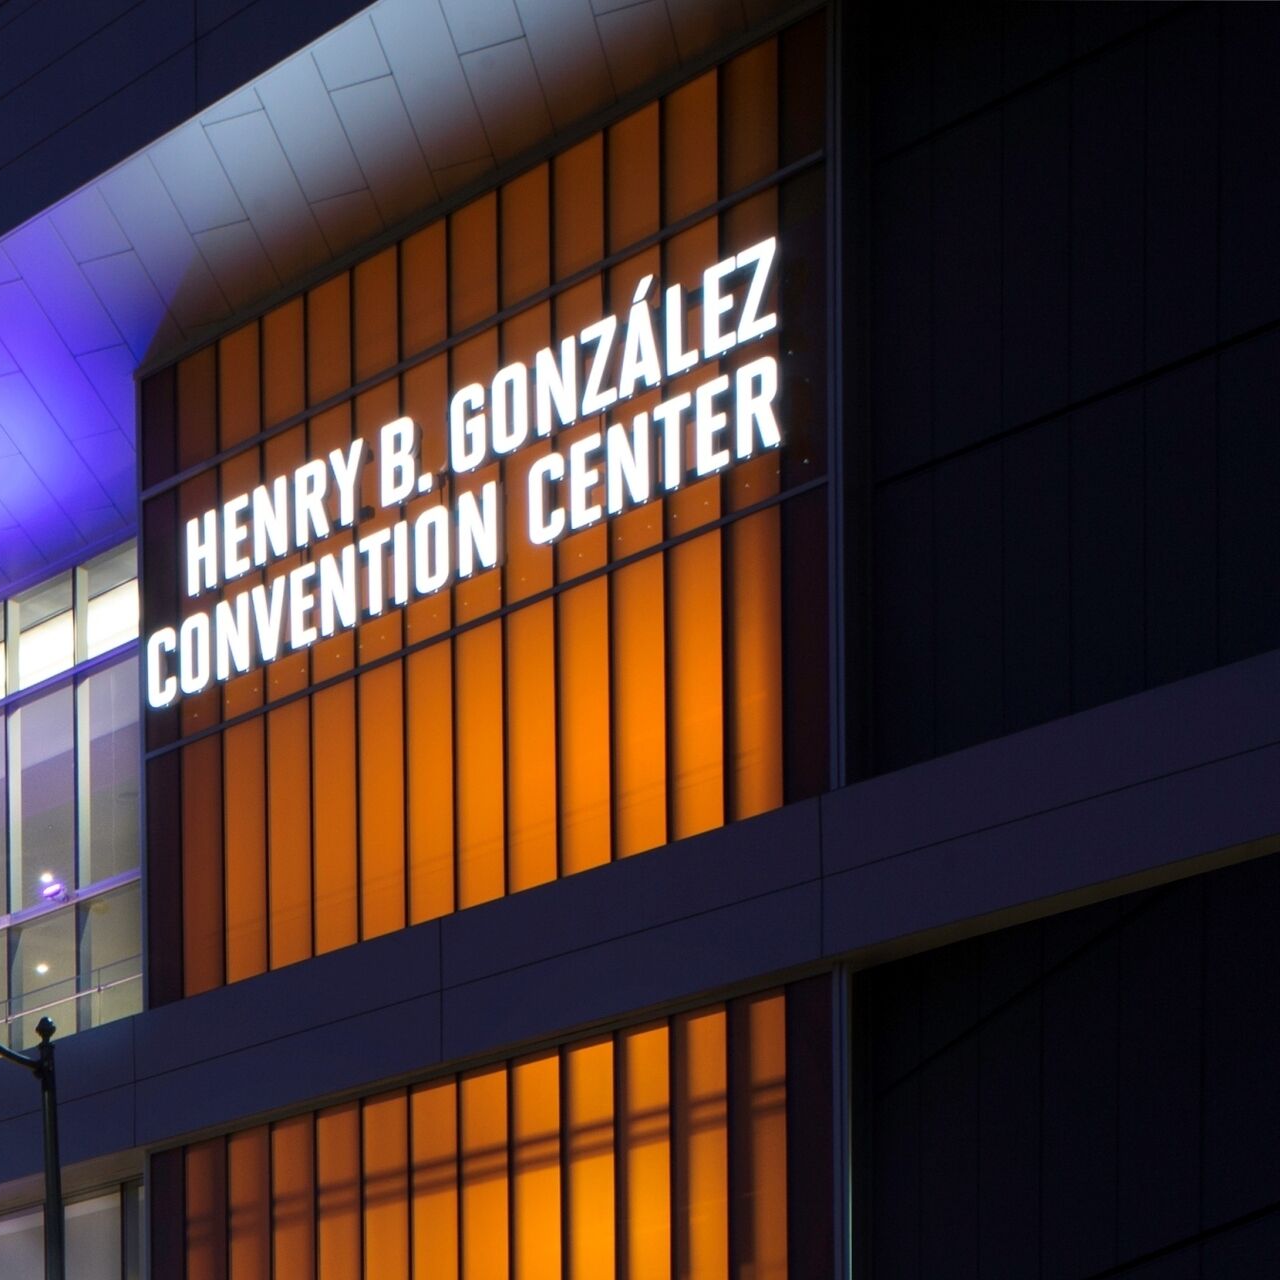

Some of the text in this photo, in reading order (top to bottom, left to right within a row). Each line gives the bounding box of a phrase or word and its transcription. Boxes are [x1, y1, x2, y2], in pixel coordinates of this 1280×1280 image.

[145, 355, 783, 708] CONVENTION CENTER
[186, 236, 778, 598] HENRY B. GONZÁLEZ
